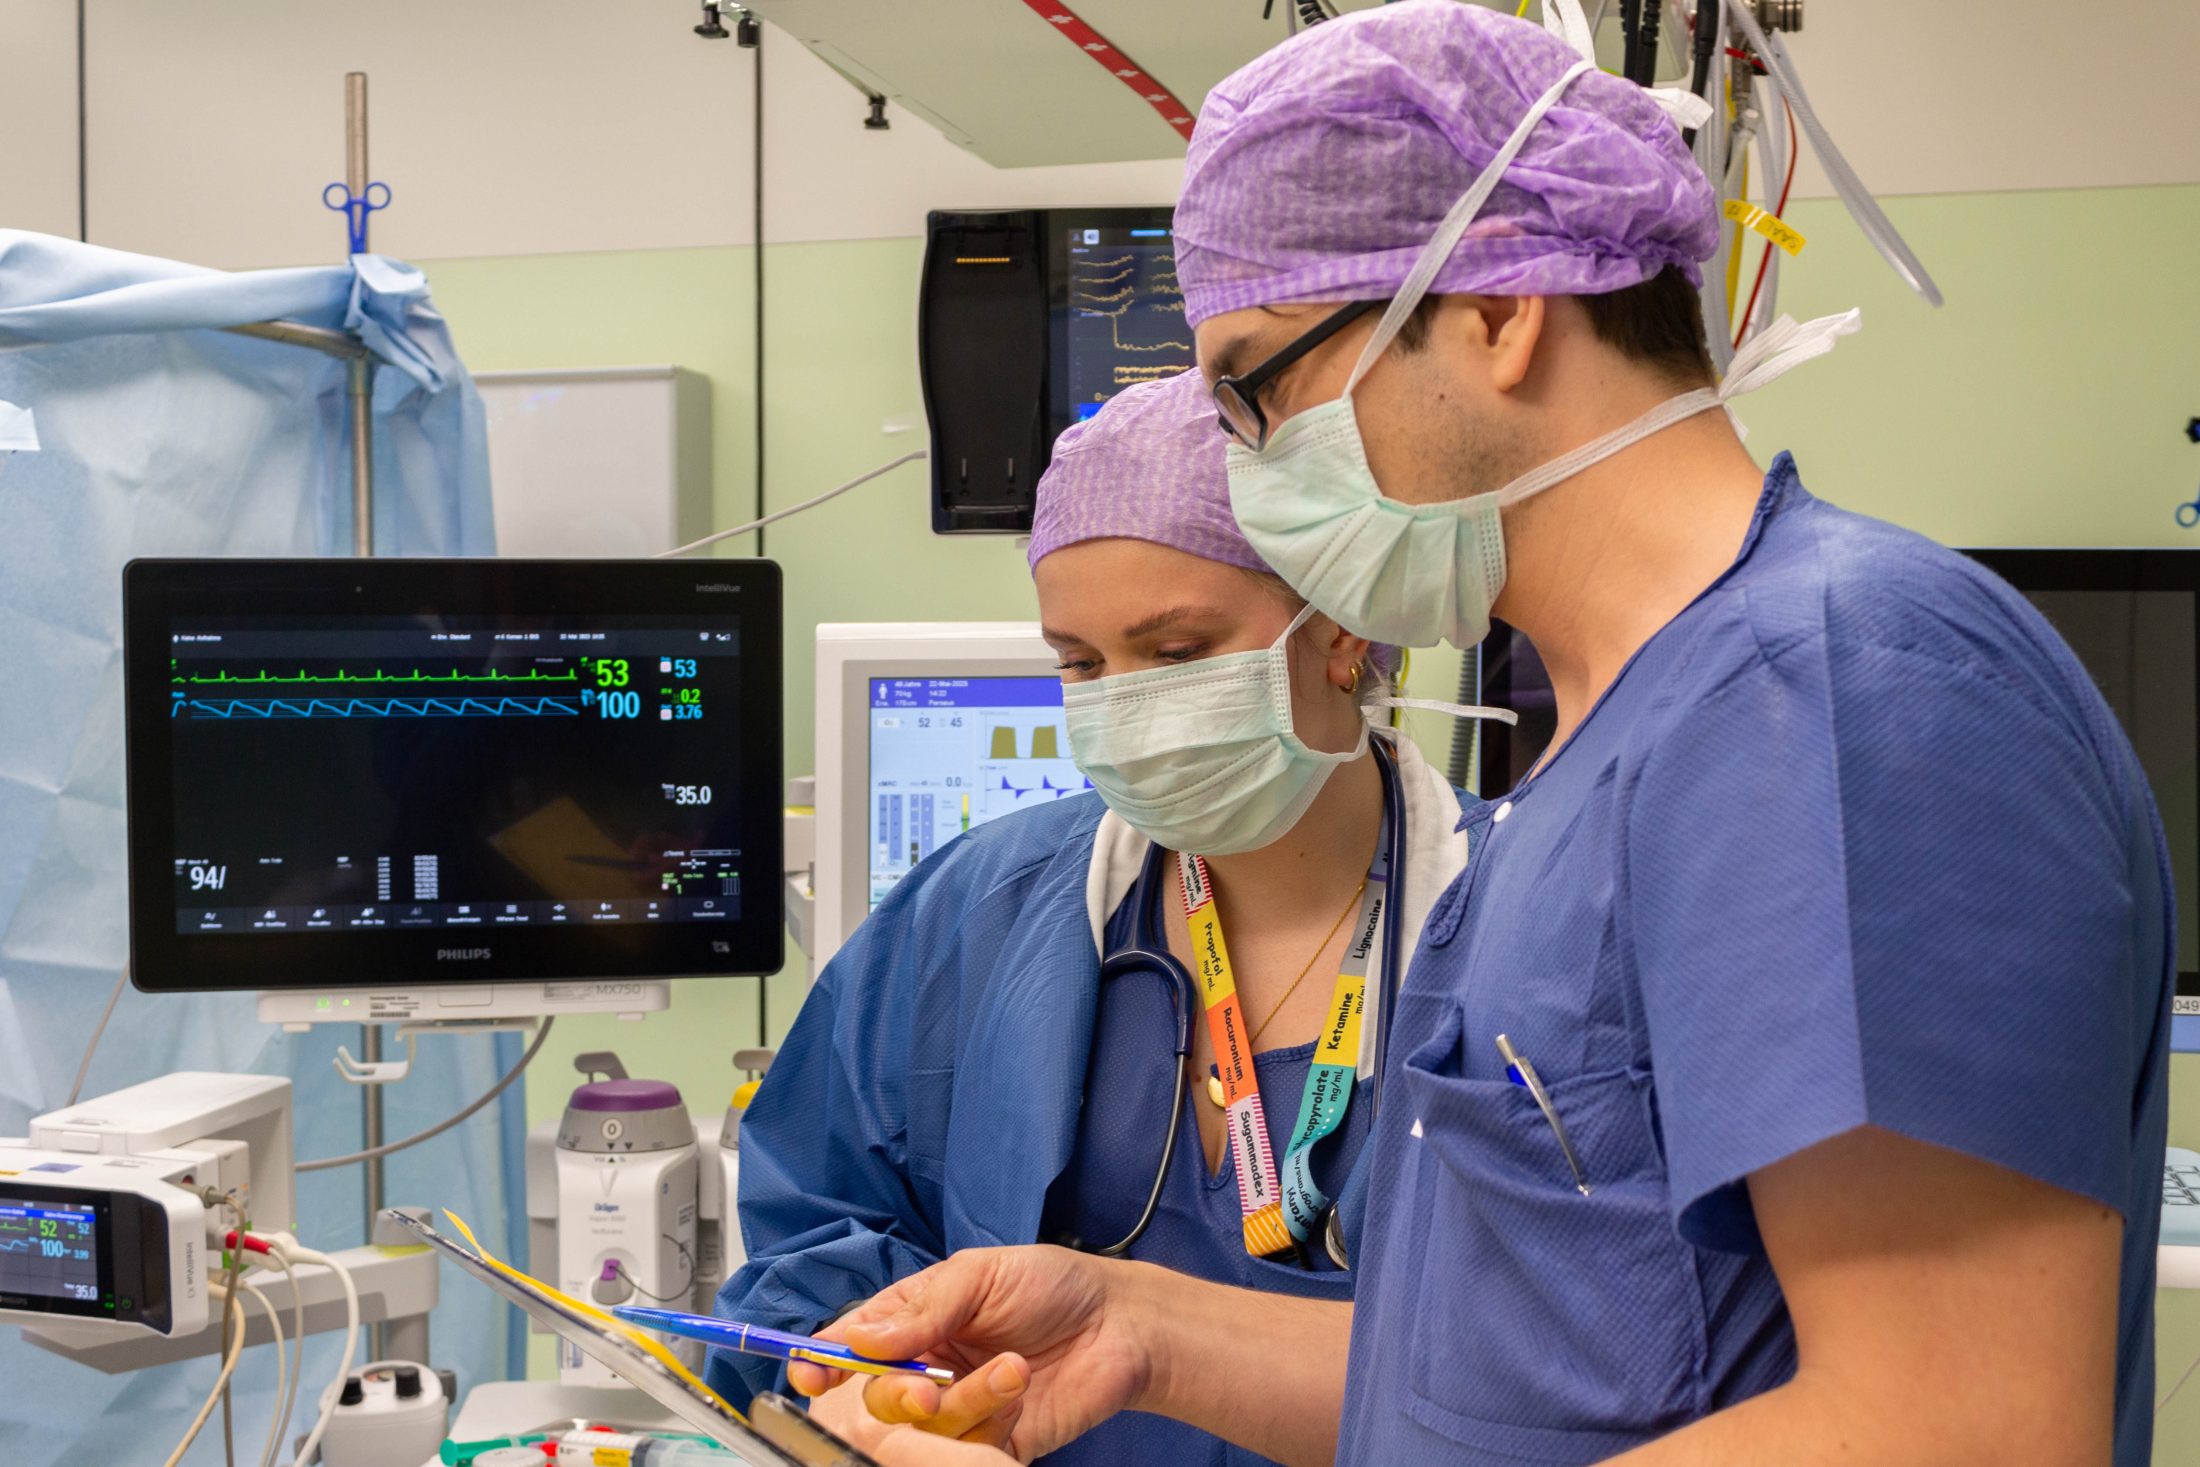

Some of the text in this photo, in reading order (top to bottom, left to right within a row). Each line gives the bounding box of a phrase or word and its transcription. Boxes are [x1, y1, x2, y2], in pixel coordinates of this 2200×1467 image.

[596, 659, 629, 687] 53
[674, 659, 697, 678] 53
[596, 691, 640, 719] 100
[680, 688, 700, 704] 0.2
[674, 704, 703, 720] 3.76
[918, 718, 931, 728] 52
[950, 717, 963, 728] 45
[945, 776, 962, 788] 0.0
[676, 785, 712, 805] 35.0
[190, 865, 226, 890] 94/
[1185, 876, 1198, 906] mg/mL
[1352, 898, 1383, 960] Lignocaine
[437, 948, 492, 960] PHILIPS
[1204, 922, 1223, 976] Propofol
[1204, 960, 1216, 991] mg/mL
[596, 983, 642, 995] MX750
[1326, 992, 1354, 1050] Ketamine
[1223, 1007, 1243, 1081] Rocuronium
[1225, 1066, 1237, 1100] mg/mL
[1330, 1068, 1344, 1102] mg/mL
[607, 1123, 617, 1136] 0
[1240, 1110, 1264, 1198] Sugammadex
[40, 1219, 57, 1238] 52
[77, 1223, 91, 1235] 52
[40, 1239, 64, 1258] 100
[75, 1285, 98, 1300] 35.0
